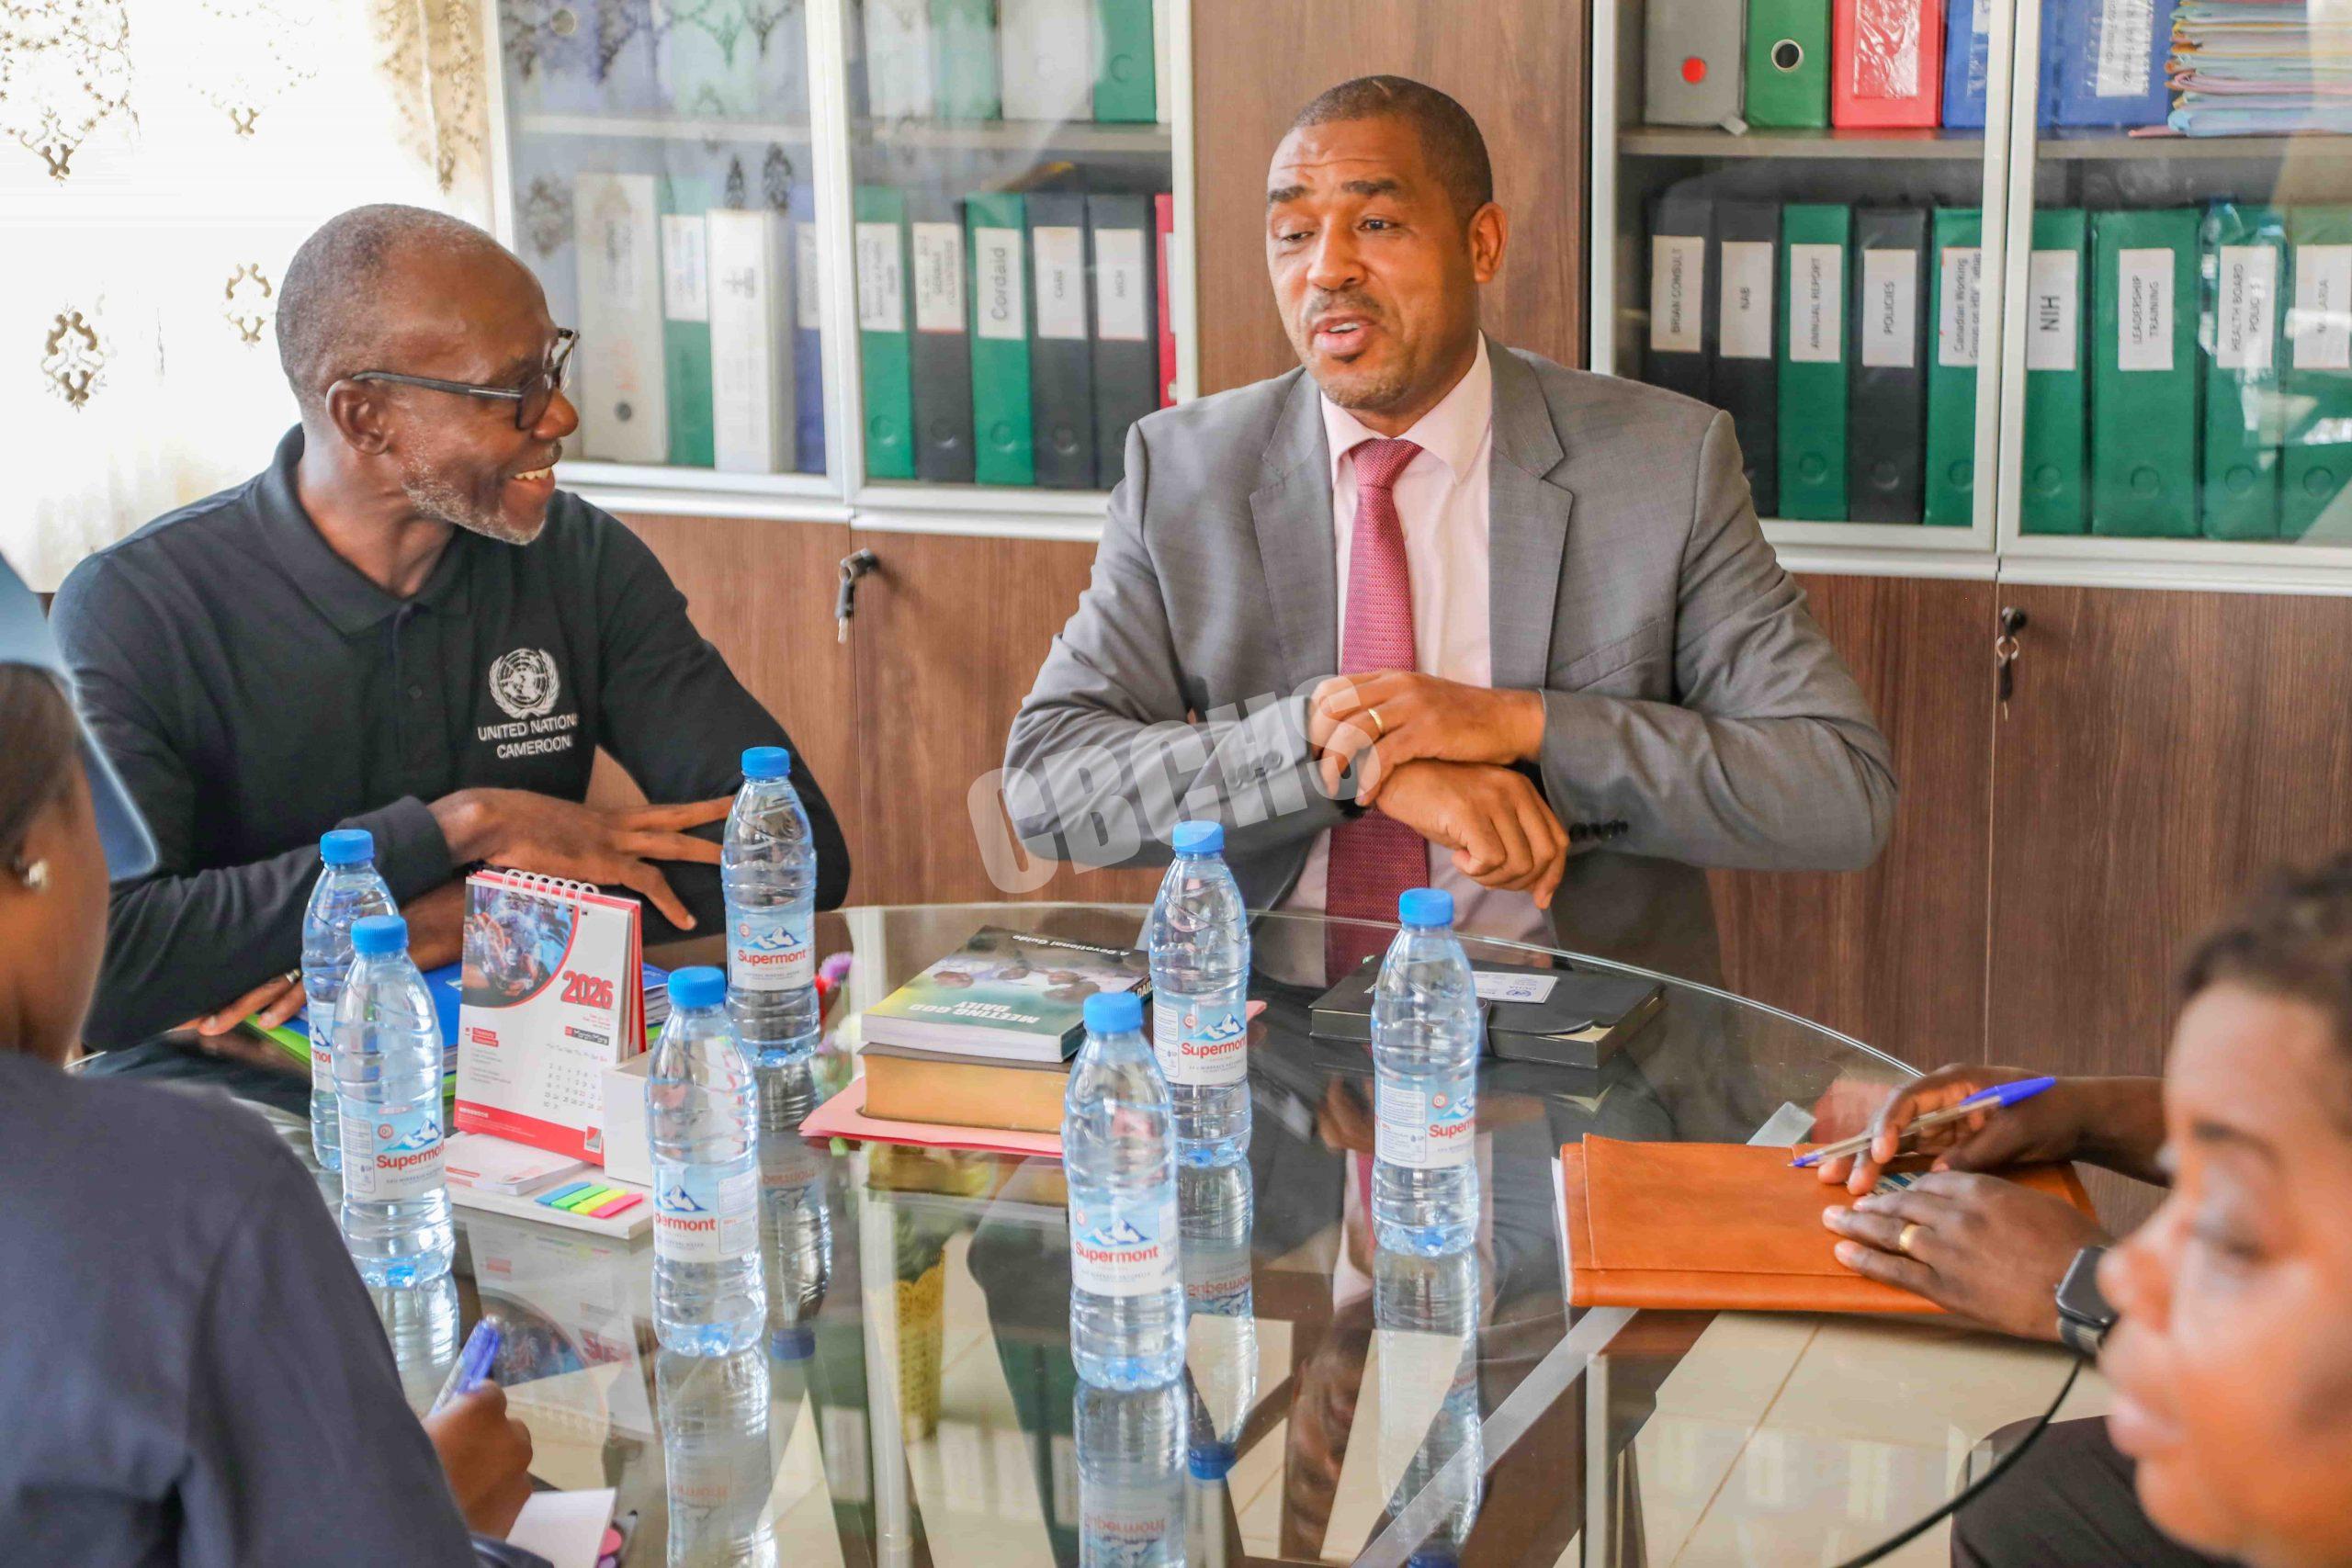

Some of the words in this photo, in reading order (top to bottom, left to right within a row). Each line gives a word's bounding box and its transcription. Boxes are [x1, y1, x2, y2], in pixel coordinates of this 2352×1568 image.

[989, 248, 1008, 321] Cordaid
[1670, 248, 1683, 297] CONSULT
[1810, 256, 1821, 299] REPORT
[1954, 258, 1968, 300] Working
[2232, 264, 2244, 304] BOARD
[1670, 300, 1682, 333] BRIAN
[1739, 287, 1750, 310] NAB
[1883, 281, 1895, 335] POLICIES
[2040, 294, 2061, 332] NIH
[2132, 275, 2143, 344] LEADERSHIP
[2149, 281, 2160, 337] TRAINING
[1810, 303, 1821, 350] ANNUAL
[1953, 304, 1965, 353] Canadian
[2231, 307, 2242, 352] HEALTH
[477, 722, 529, 742] UNITED
[497, 734, 572, 759] CAMEROON
[737, 949, 807, 966] Supermont
[1012, 934, 1046, 945] Guide
[1048, 938, 1117, 955] Devotional
[560, 970, 614, 1010] 2026
[908, 1003, 951, 1014] GOD
[954, 1001, 1012, 1012] DAILY
[952, 1007, 1040, 1023] MEETING
[1075, 1240, 1159, 1263] Supermont
